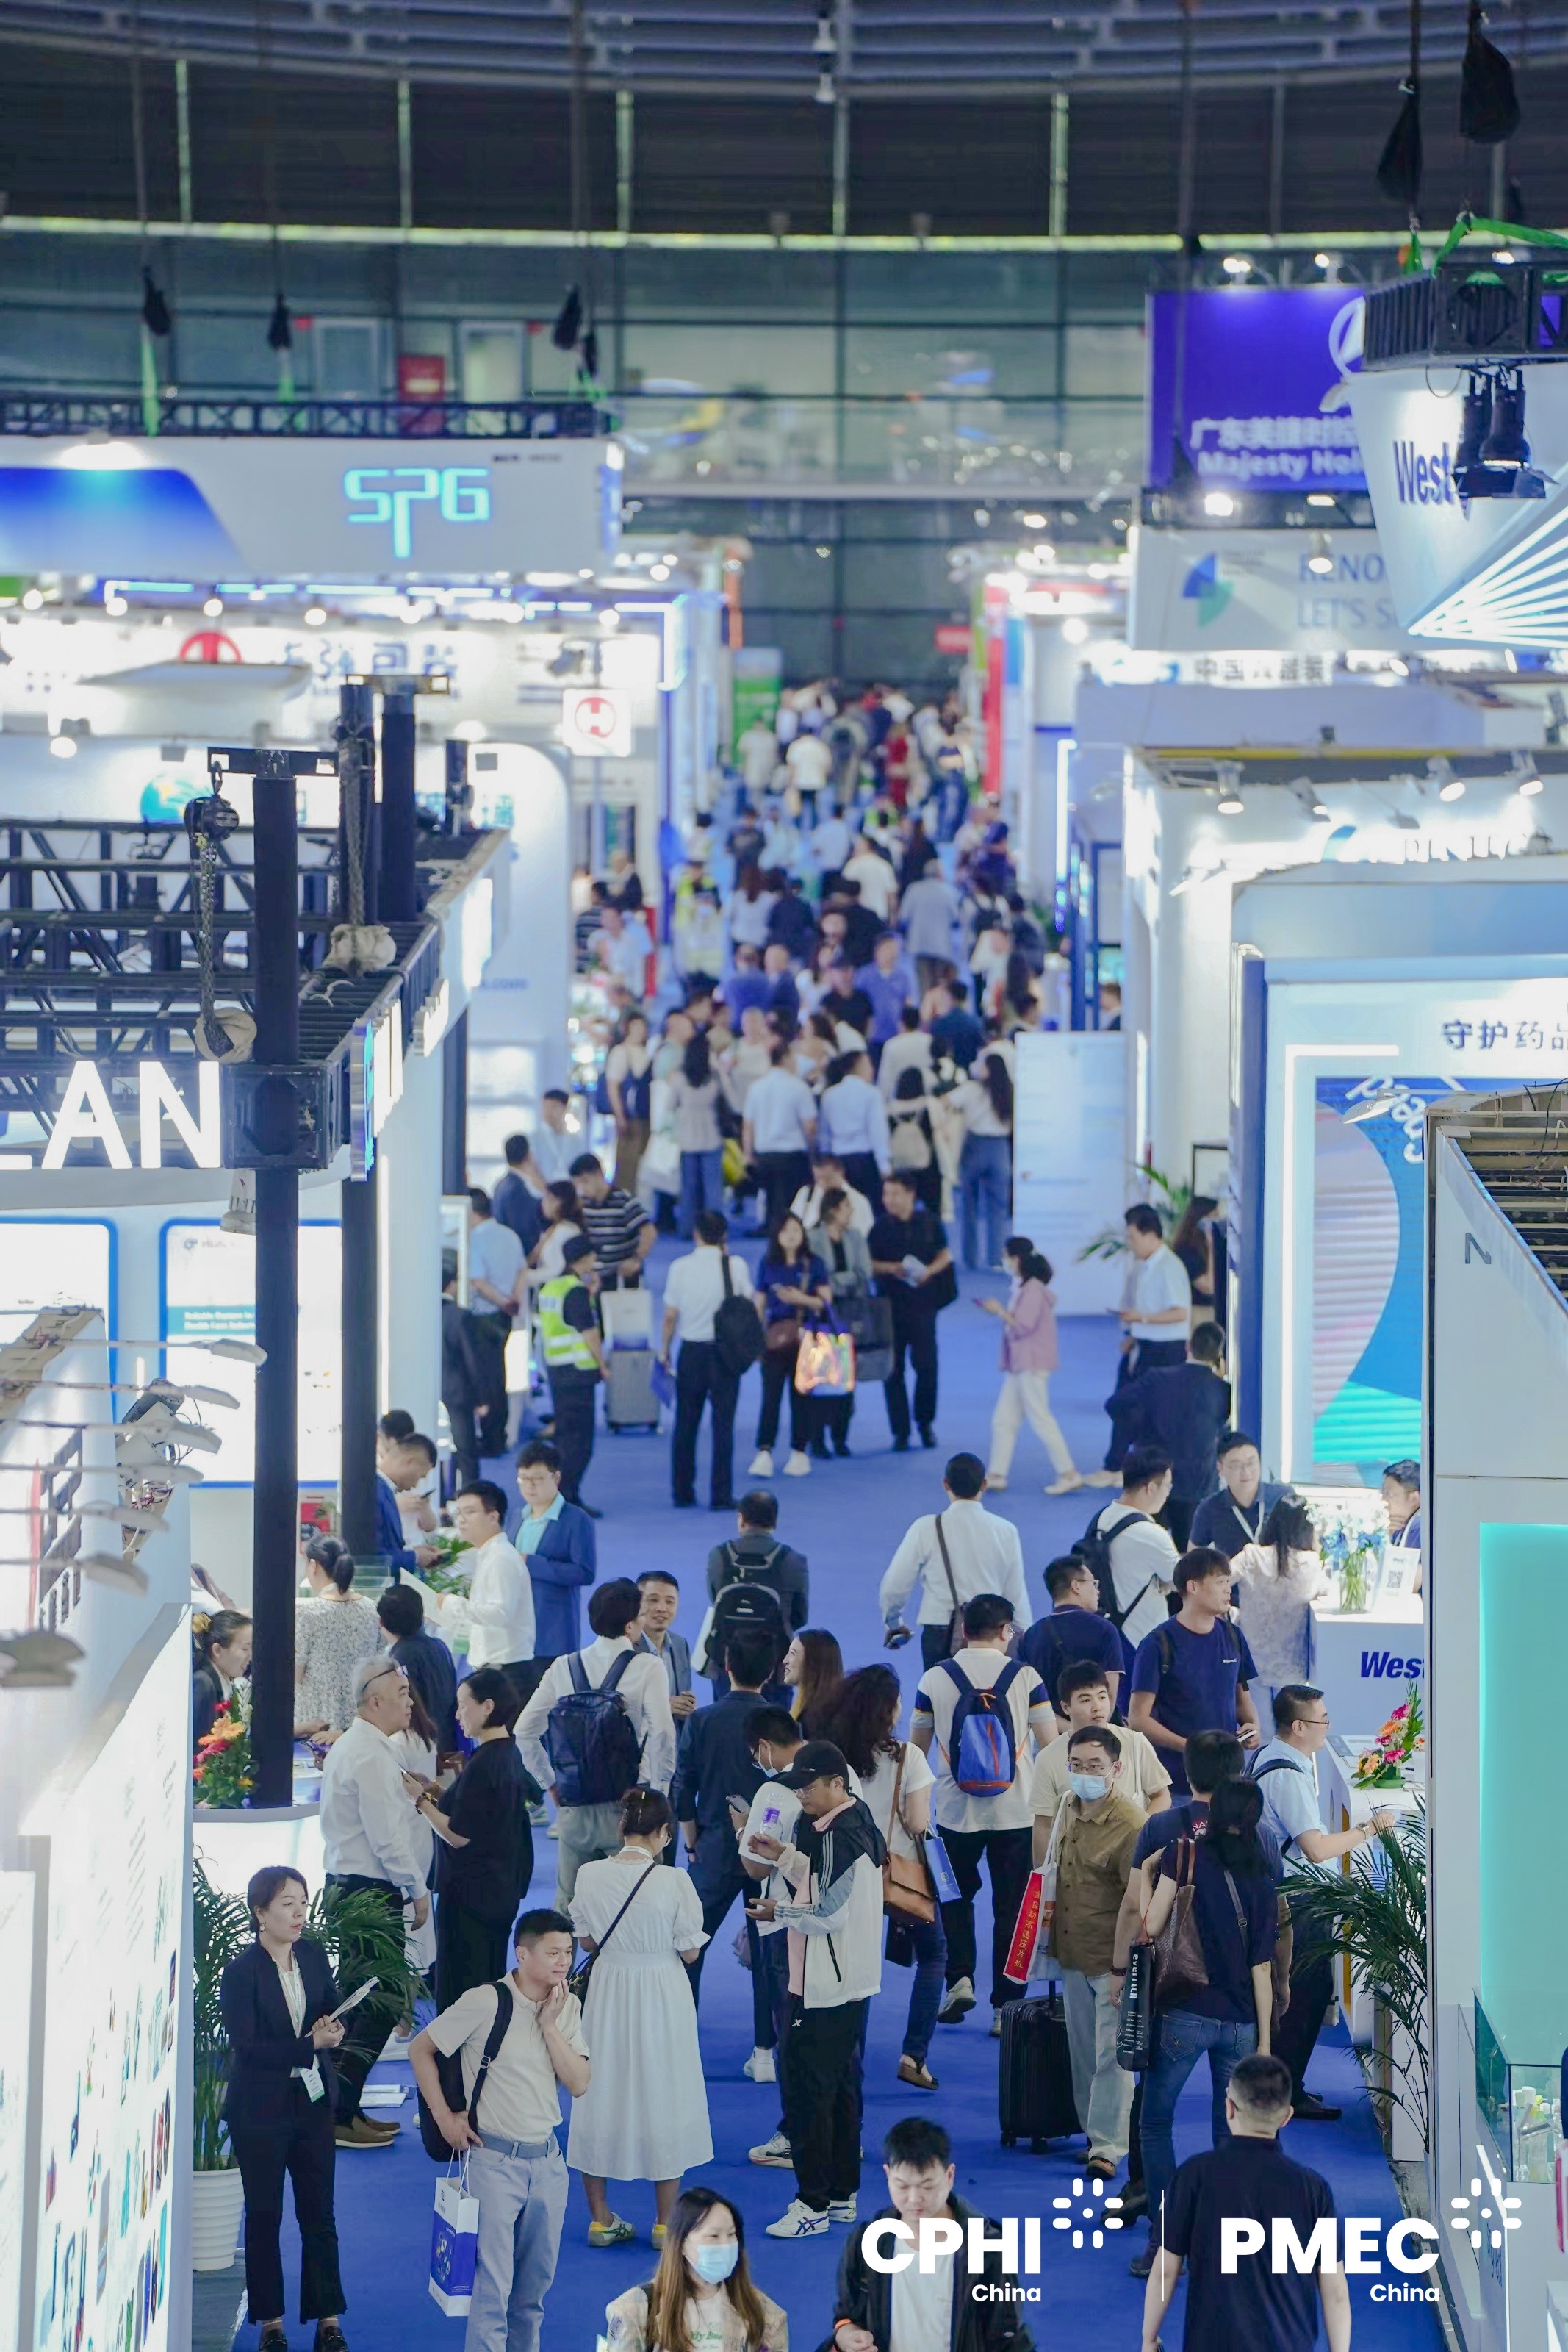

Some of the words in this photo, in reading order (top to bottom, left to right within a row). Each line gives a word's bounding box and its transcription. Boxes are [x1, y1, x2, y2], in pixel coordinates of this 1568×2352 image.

[1198, 451, 1308, 481] Majesty
[1392, 440, 1454, 505] West
[344, 468, 489, 558] SPG
[1298, 598, 1367, 630] LET'S
[1361, 1652, 1425, 1679] Wes
[1192, 1821, 1209, 1832] NA
